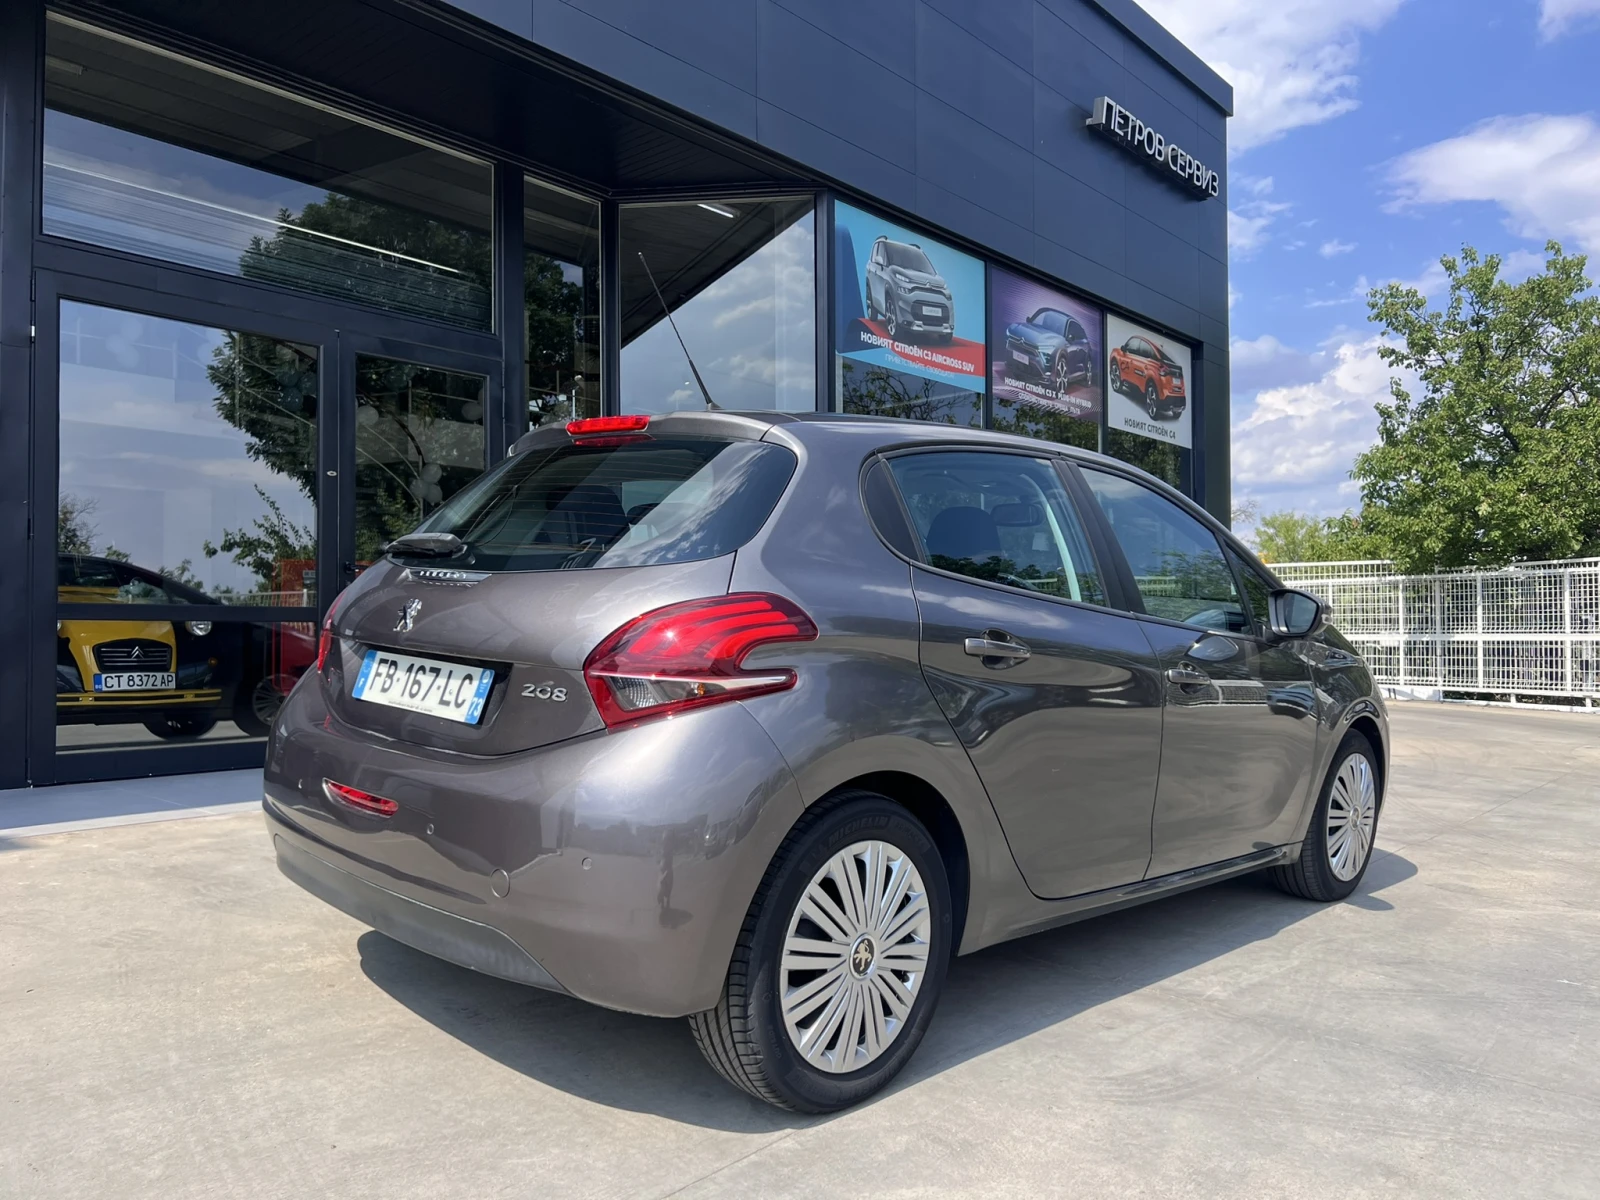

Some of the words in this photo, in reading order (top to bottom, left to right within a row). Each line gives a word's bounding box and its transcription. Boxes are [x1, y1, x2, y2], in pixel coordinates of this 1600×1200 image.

[1102, 96, 1165, 162] ПЕТРОВ
[1168, 144, 1219, 197] СЕРВИЗ
[860, 331, 893, 349] НОВИЯТ
[893, 341, 923, 358] CITROËN
[923, 350, 933, 361] C3
[932, 353, 962, 369] AIRCROSS
[962, 362, 975, 373] SUV
[1004, 377, 1026, 390] НОВИЯТ
[1025, 383, 1045, 396] CITROËN
[1124, 417, 1147, 431] НОВИЯТ
[1147, 424, 1168, 438] CITROËN
[1168, 430, 1176, 440] C4
[104, 674, 124, 689] CT
[127, 674, 158, 688] 8372
[160, 674, 174, 687] AP
[521, 683, 567, 702] 208
[468, 697, 483, 717] 73
